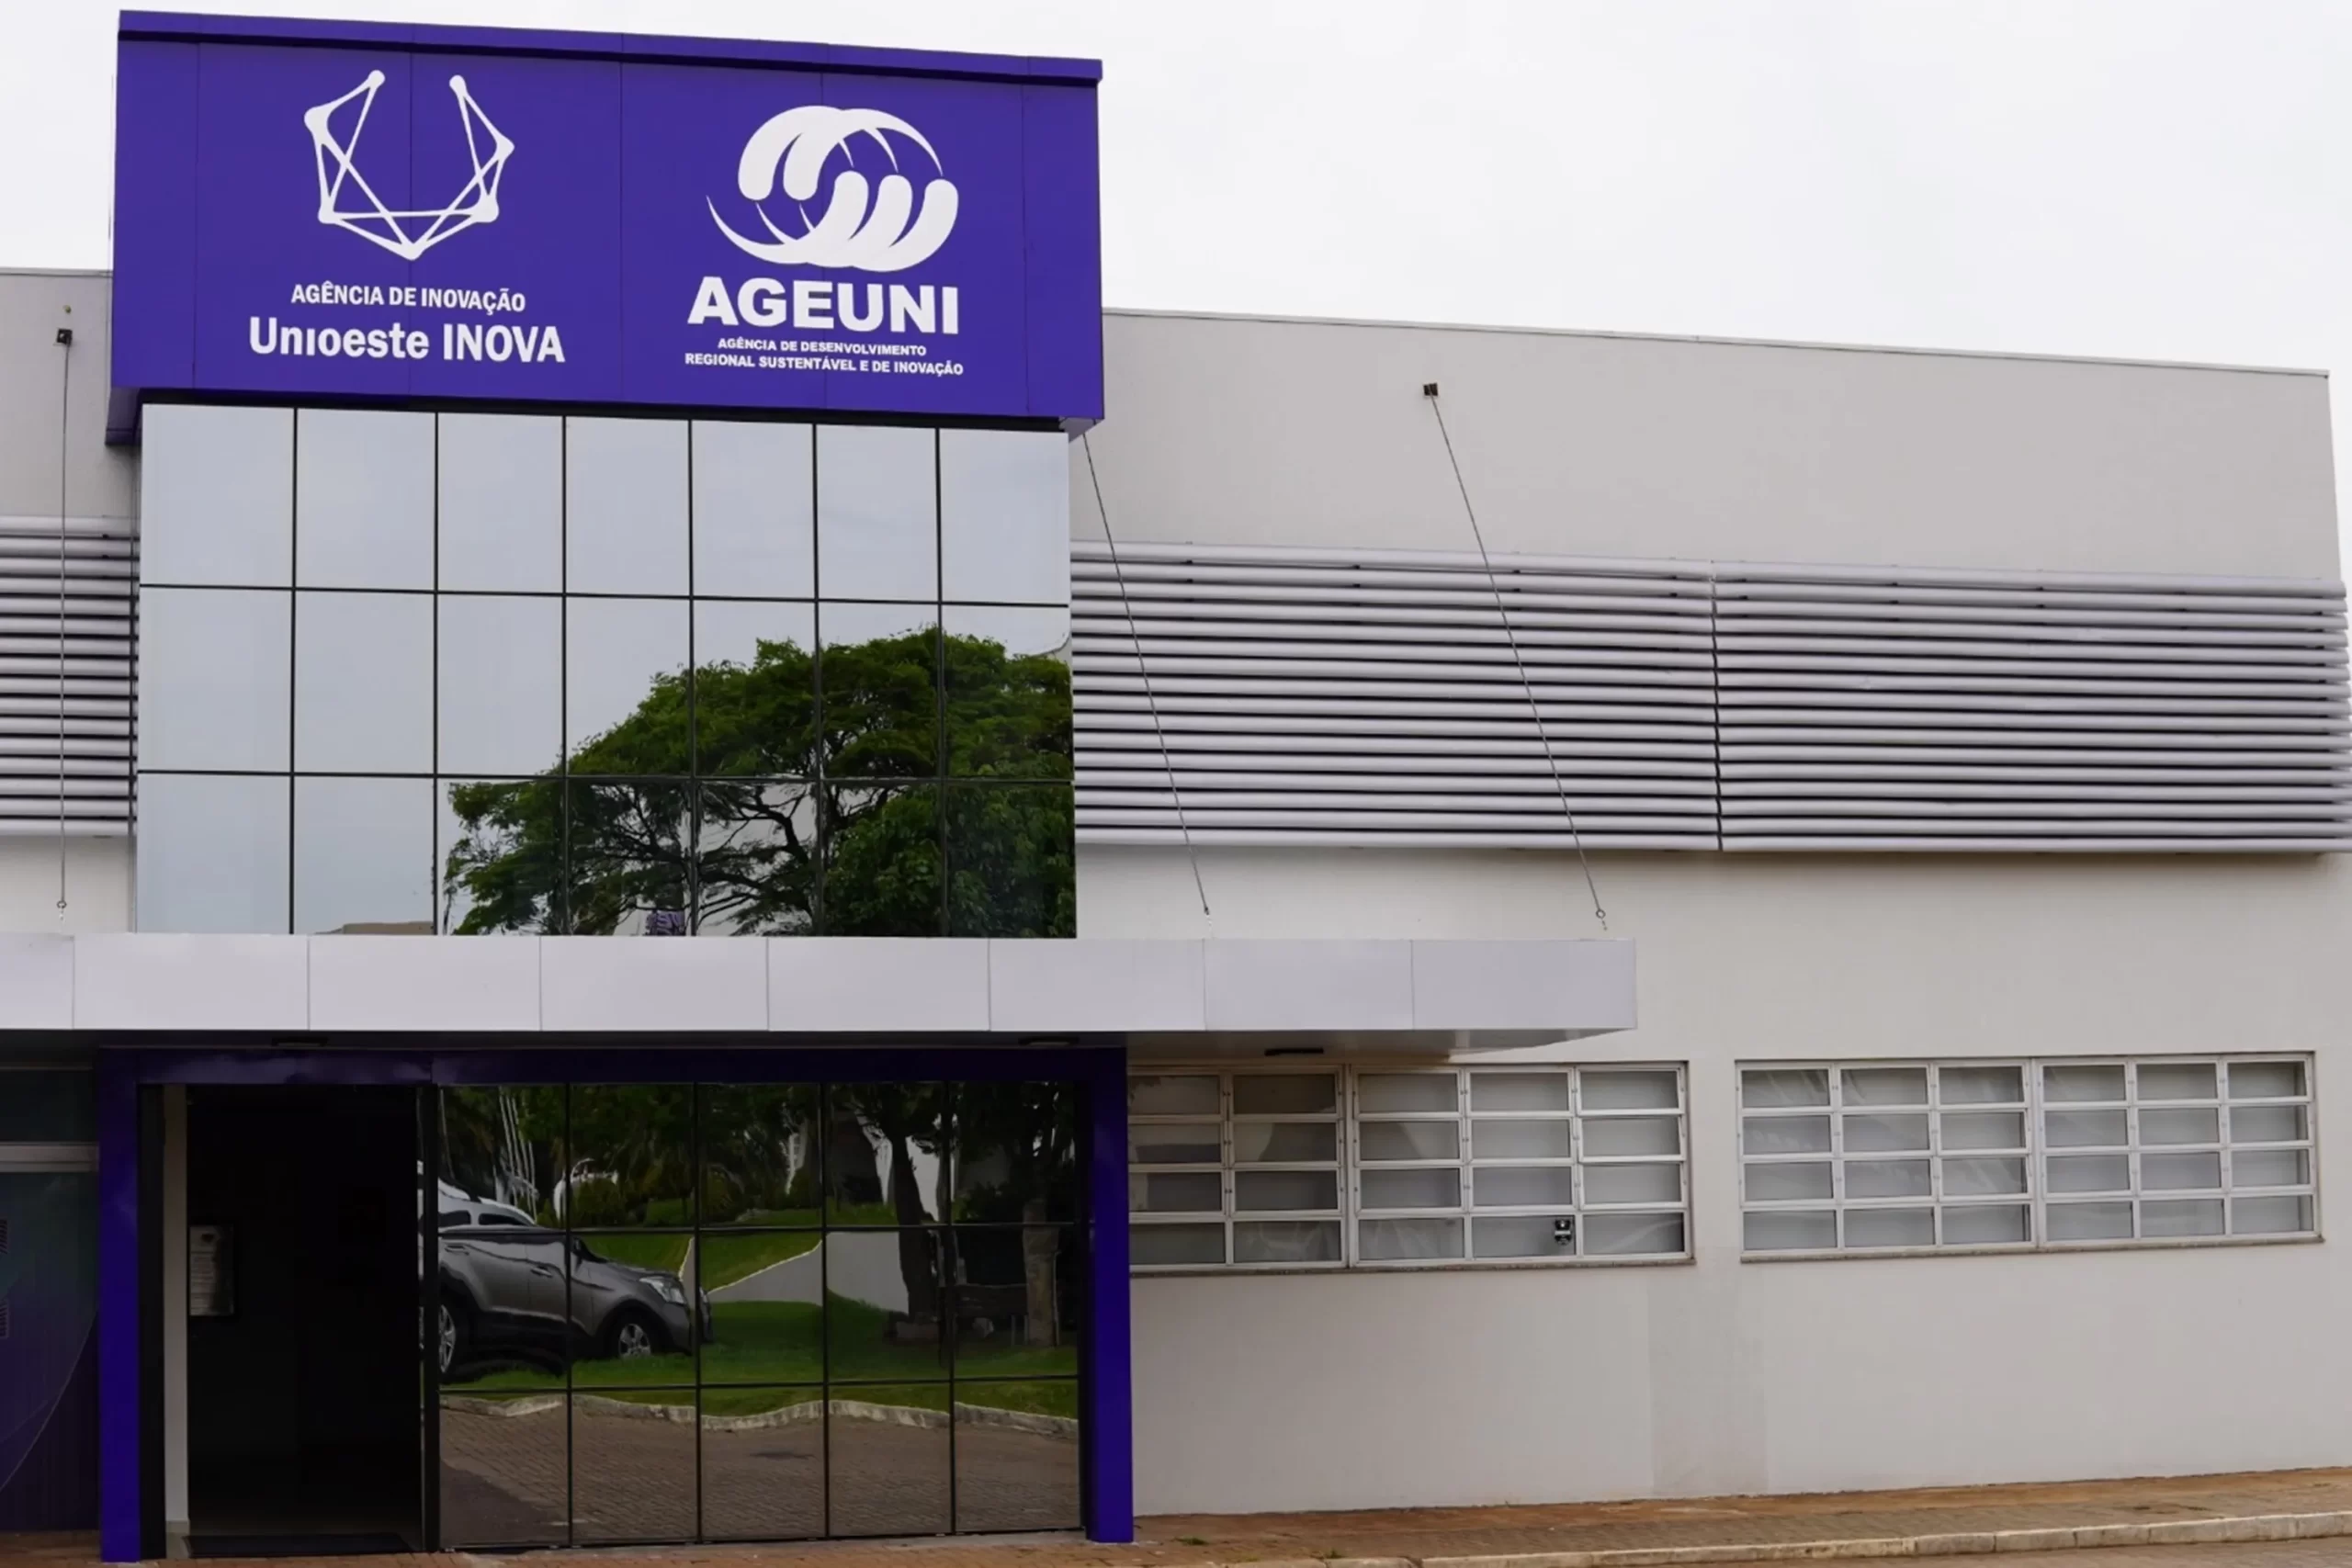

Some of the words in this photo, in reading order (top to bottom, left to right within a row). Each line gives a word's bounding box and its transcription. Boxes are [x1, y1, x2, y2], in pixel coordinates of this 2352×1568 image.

[291, 280, 384, 306] AGÊNCIA
[389, 286, 417, 307] DE
[421, 287, 526, 316] INOVAÇÃO
[687, 276, 959, 334] AGEUNI
[443, 323, 566, 363] INOVA
[718, 336, 777, 351] AGÊNCIA
[781, 340, 797, 352] DE
[800, 341, 927, 356] DESENVOLVIMENTO
[684, 353, 756, 367] REGIONAL
[758, 355, 857, 371] SUSTENTÁVEL
[859, 359, 869, 372] E
[871, 360, 890, 373] DE
[893, 360, 964, 378] INOVAÇÃO
